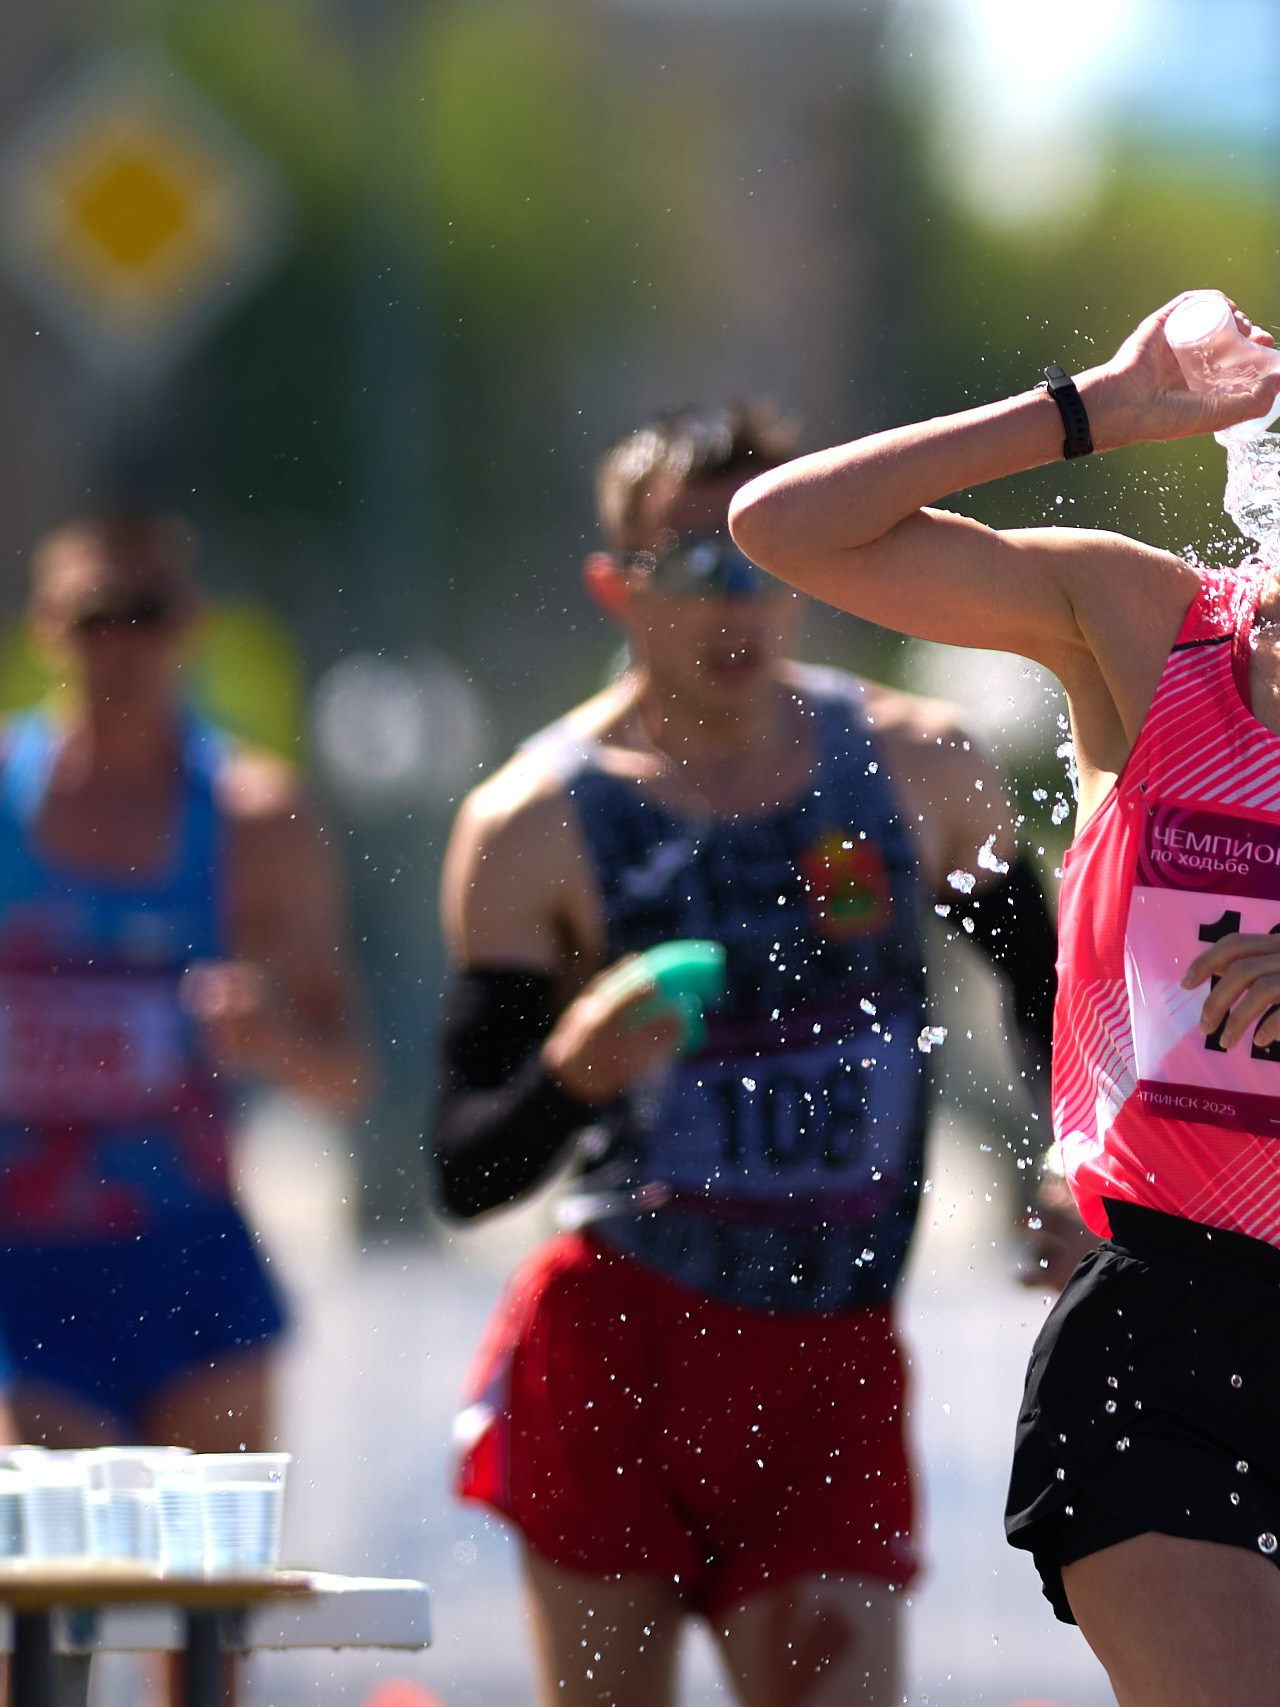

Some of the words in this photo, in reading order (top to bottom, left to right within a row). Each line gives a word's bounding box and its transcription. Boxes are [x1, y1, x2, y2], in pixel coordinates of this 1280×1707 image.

[1150, 849, 1172, 862] по
[1178, 853, 1249, 875] ходьбе
[1202, 1100, 1236, 1117] 2025
